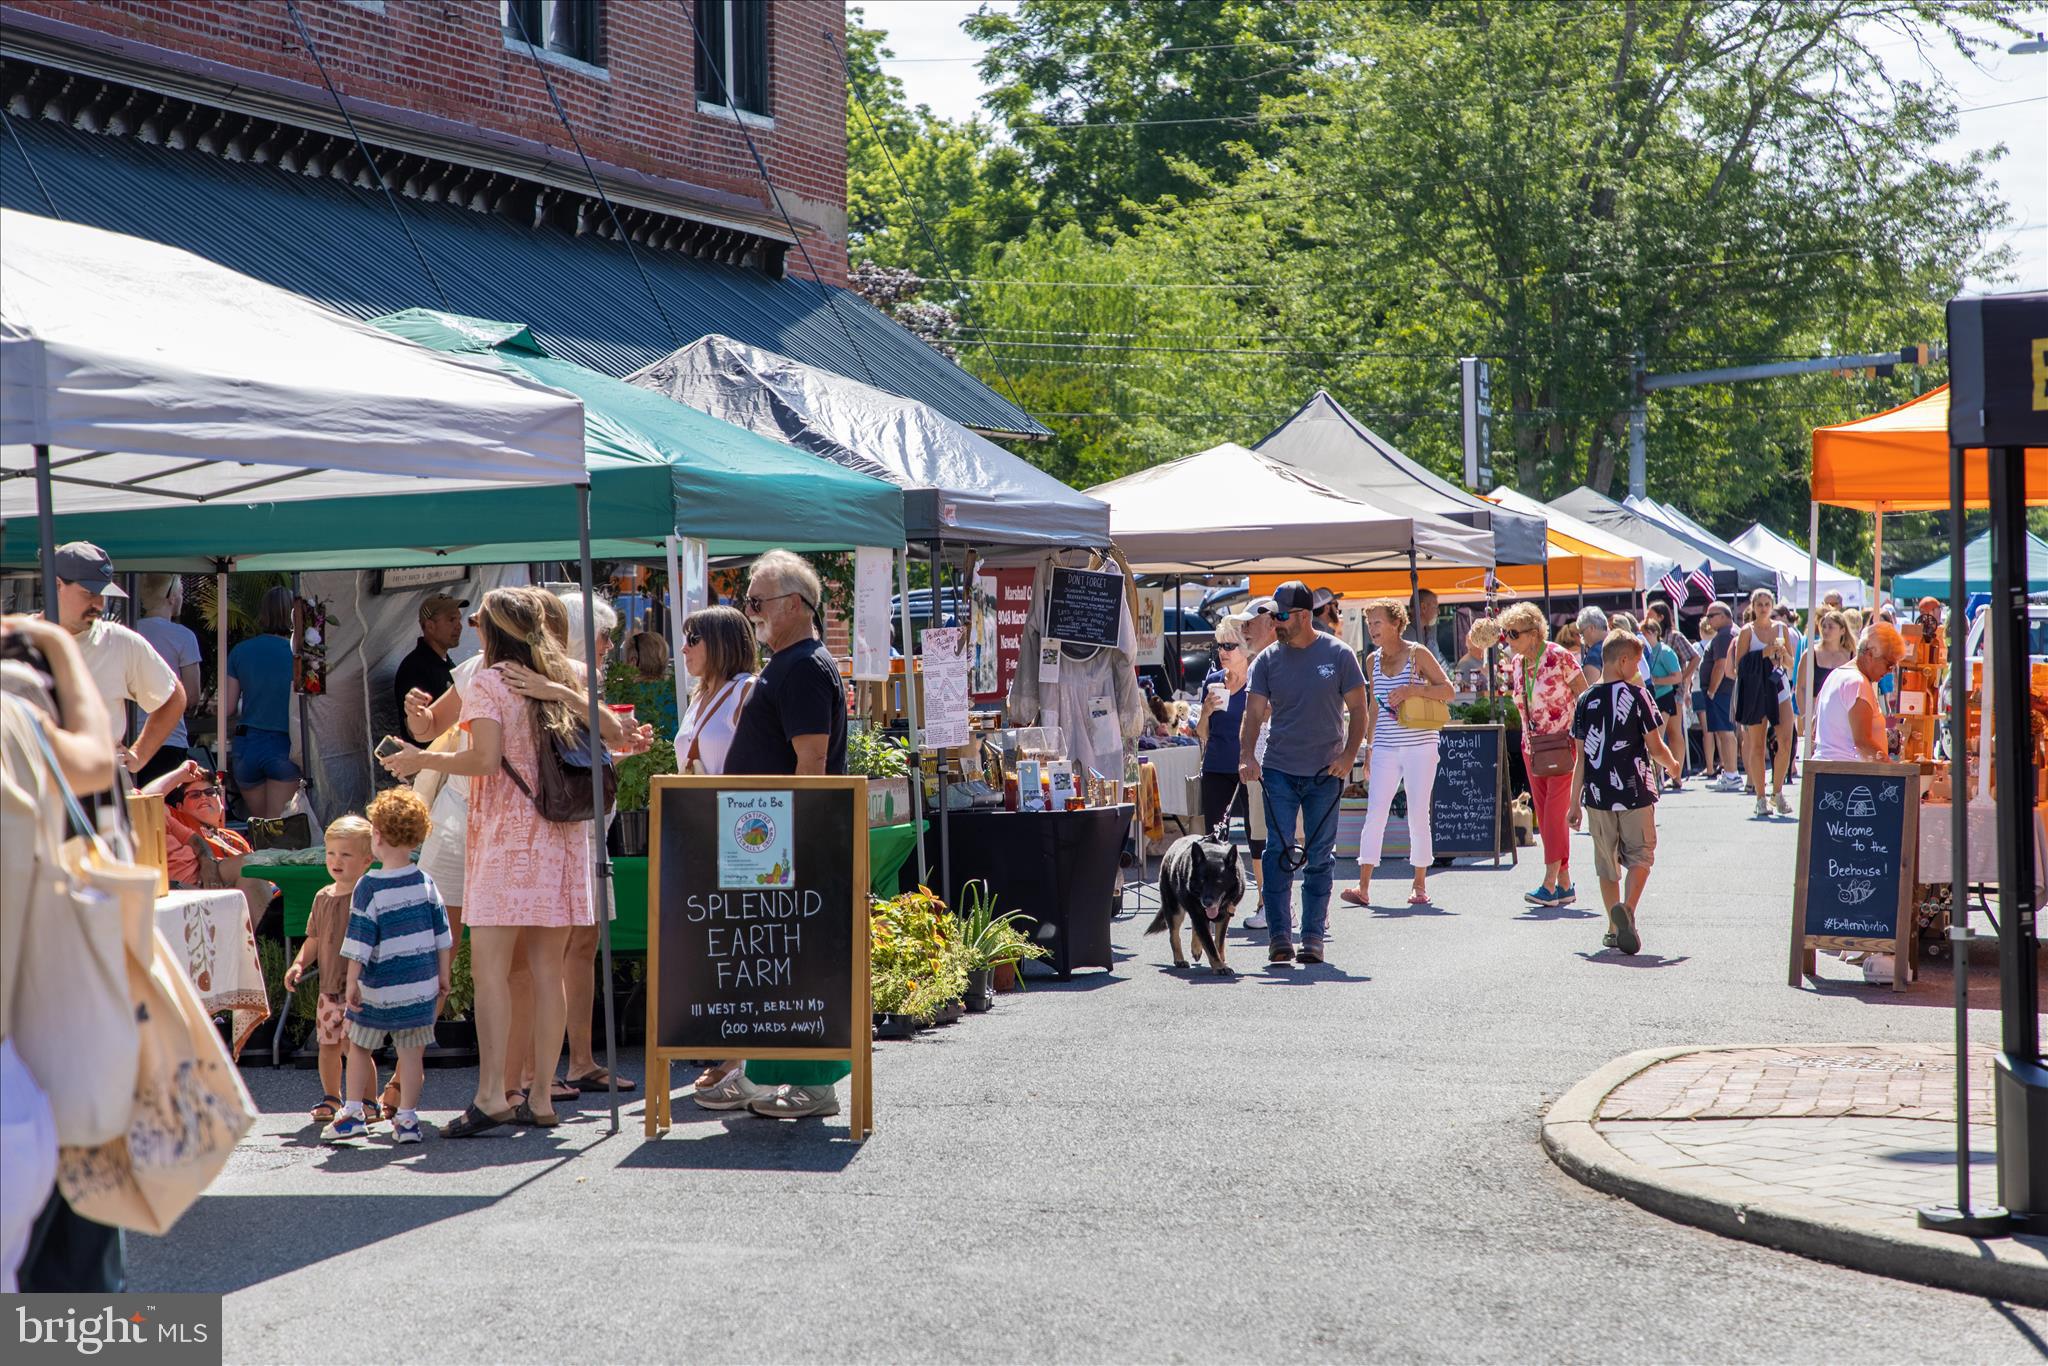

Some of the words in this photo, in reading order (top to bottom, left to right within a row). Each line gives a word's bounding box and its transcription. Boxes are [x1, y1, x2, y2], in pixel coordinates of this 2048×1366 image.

[1005, 586, 1026, 600] Marshall
[1012, 610, 1027, 624] Marsh
[1439, 734, 1480, 748] Marshall
[1584, 724, 1602, 760] NIKE
[1448, 748, 1476, 760] Creek
[1462, 759, 1483, 768] Farm
[1438, 767, 1466, 780] Alpaca
[1449, 778, 1468, 787] Sheep
[1462, 788, 1482, 796] Goat
[1468, 793, 1496, 804] Products
[728, 797, 755, 808] Proud
[758, 797, 767, 808] to
[770, 796, 784, 808] Be
[1434, 800, 1474, 812] Free-Range
[741, 813, 771, 825] CERTIFIED
[1435, 821, 1456, 833] Turkey
[1826, 821, 1874, 837] Welcome
[1435, 832, 1452, 842] Duck
[1852, 839, 1866, 852] to
[1870, 841, 1888, 854] the
[1828, 858, 1882, 878] Beehouse
[687, 889, 822, 922] SPLENDID
[708, 923, 800, 957] EARTH
[717, 957, 792, 989] FARM
[708, 1002, 736, 1015] WEST
[740, 1002, 758, 1016] ST,
[808, 998, 825, 1011] MD
[721, 1020, 748, 1039] (200
[752, 1022, 787, 1033] YARDS
[790, 1016, 825, 1038] AWAY!)
